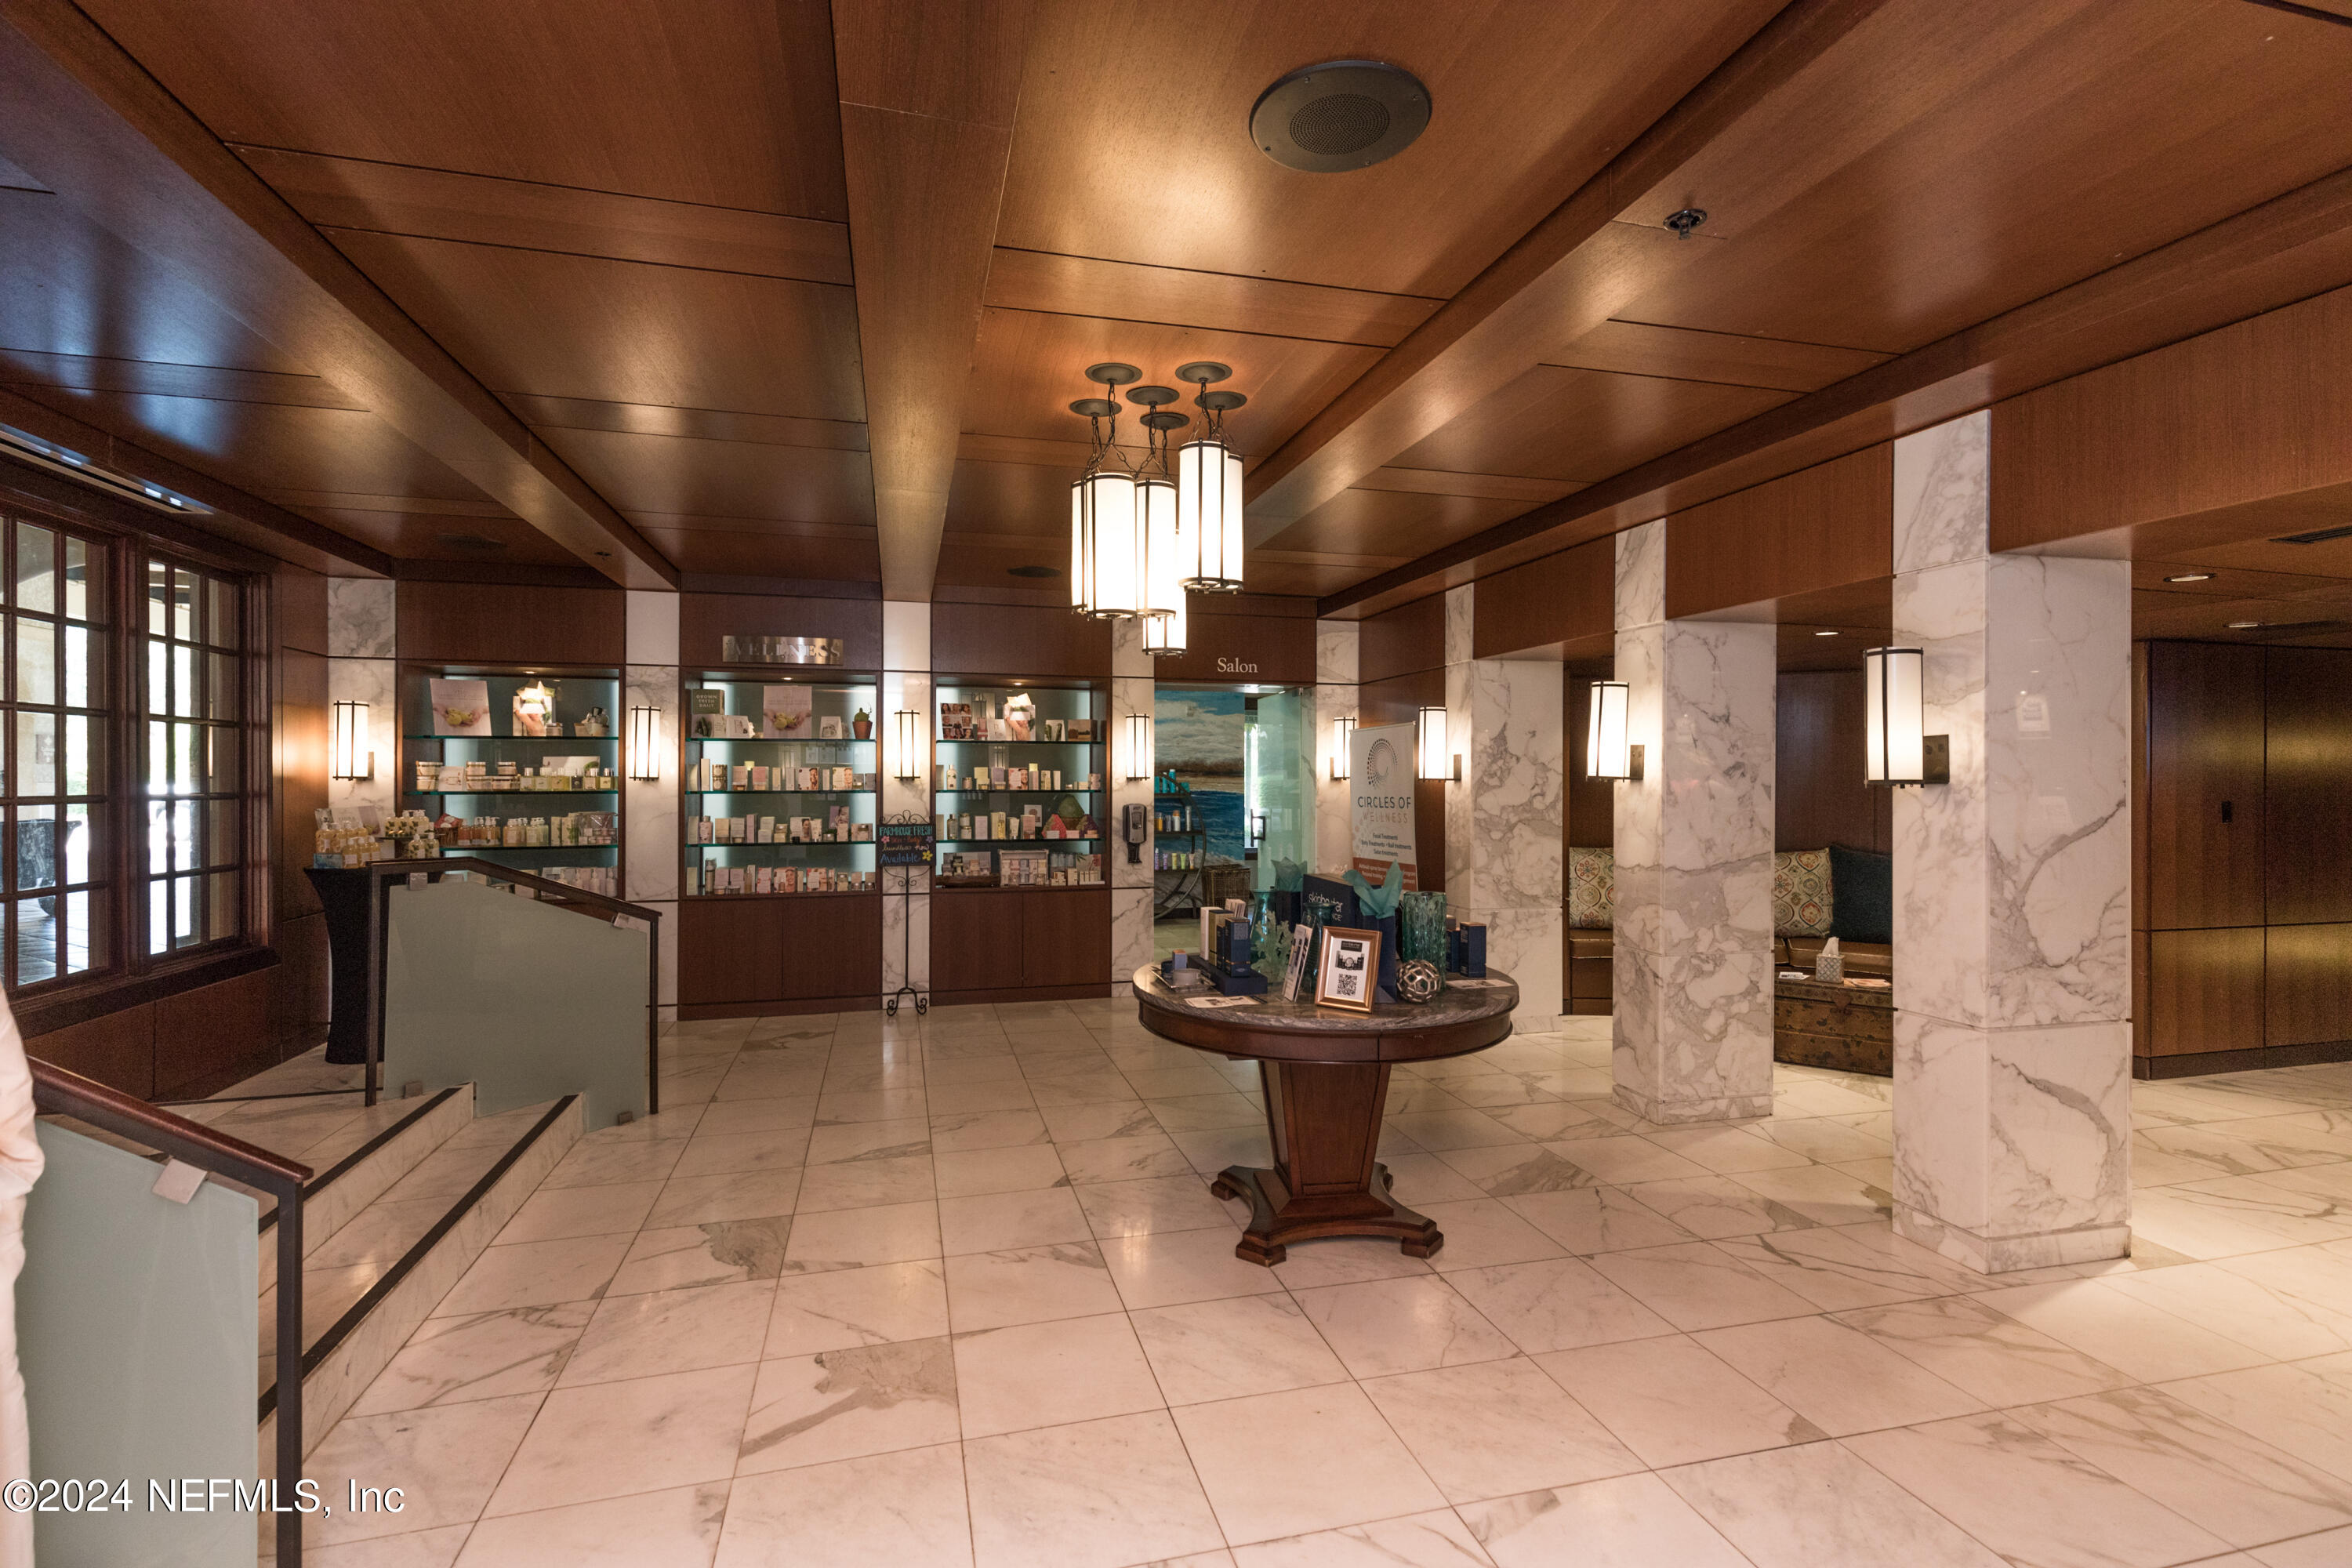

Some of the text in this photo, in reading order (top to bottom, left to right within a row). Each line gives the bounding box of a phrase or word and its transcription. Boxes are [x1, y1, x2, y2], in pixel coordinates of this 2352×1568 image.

[1217, 657, 1259, 673] Salon
[1357, 796, 1411, 809] CIRCLES OF
[1363, 811, 1408, 823] WELLNESS
[879, 826, 932, 836] FARMHOUSE FRESH
[880, 853, 921, 863] Available
